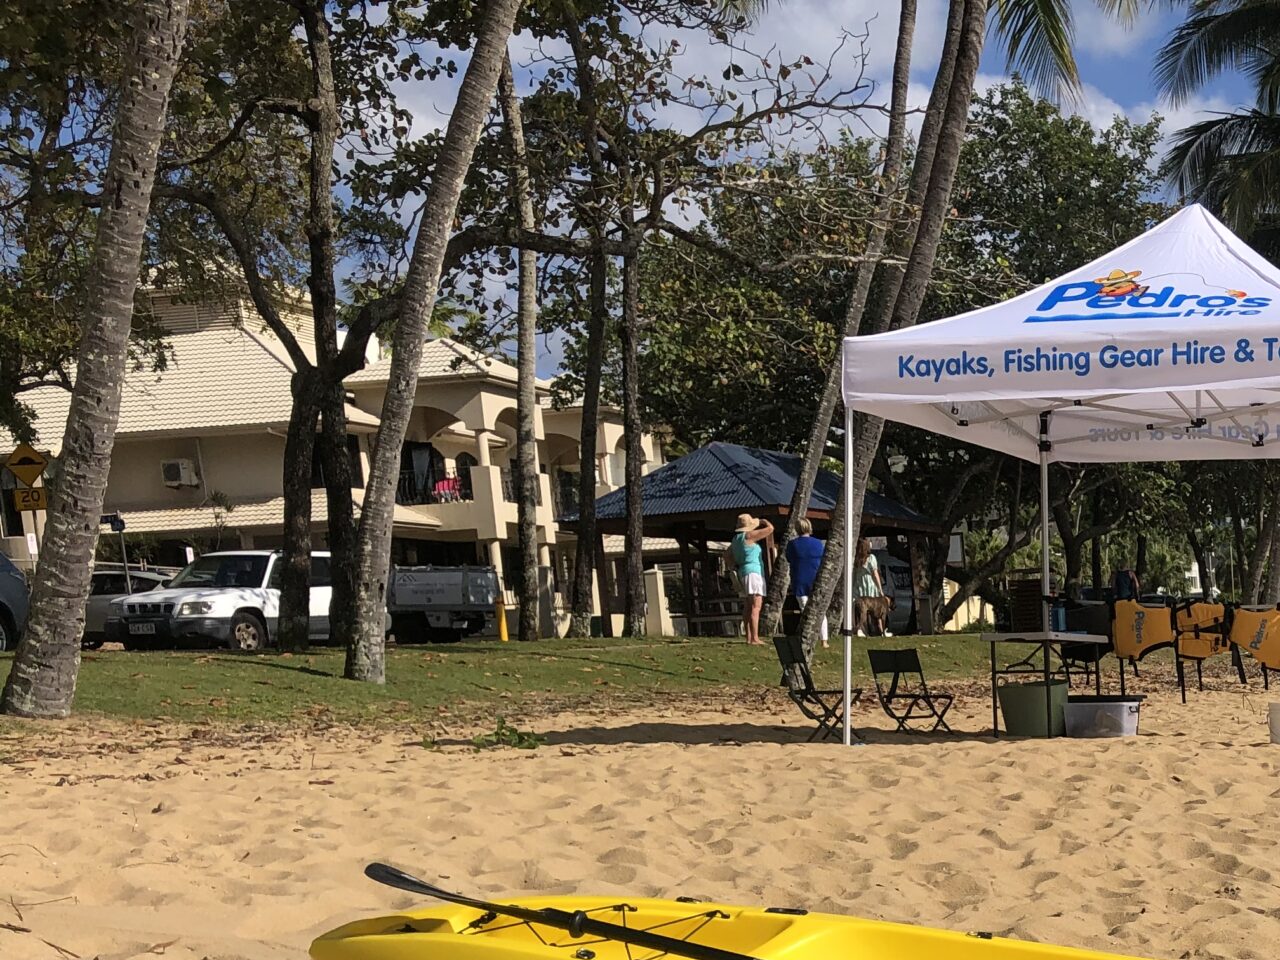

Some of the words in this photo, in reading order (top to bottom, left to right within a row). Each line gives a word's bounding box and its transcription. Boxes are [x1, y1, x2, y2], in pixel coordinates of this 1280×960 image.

[1182, 308, 1262, 318] Hire
[898, 350, 995, 382] Kayaks,
[1004, 346, 1090, 376] Fishing
[1098, 344, 1164, 369] Gear
[1171, 340, 1226, 365] Hire
[1233, 338, 1255, 363] &
[20, 490, 41, 503] 20
